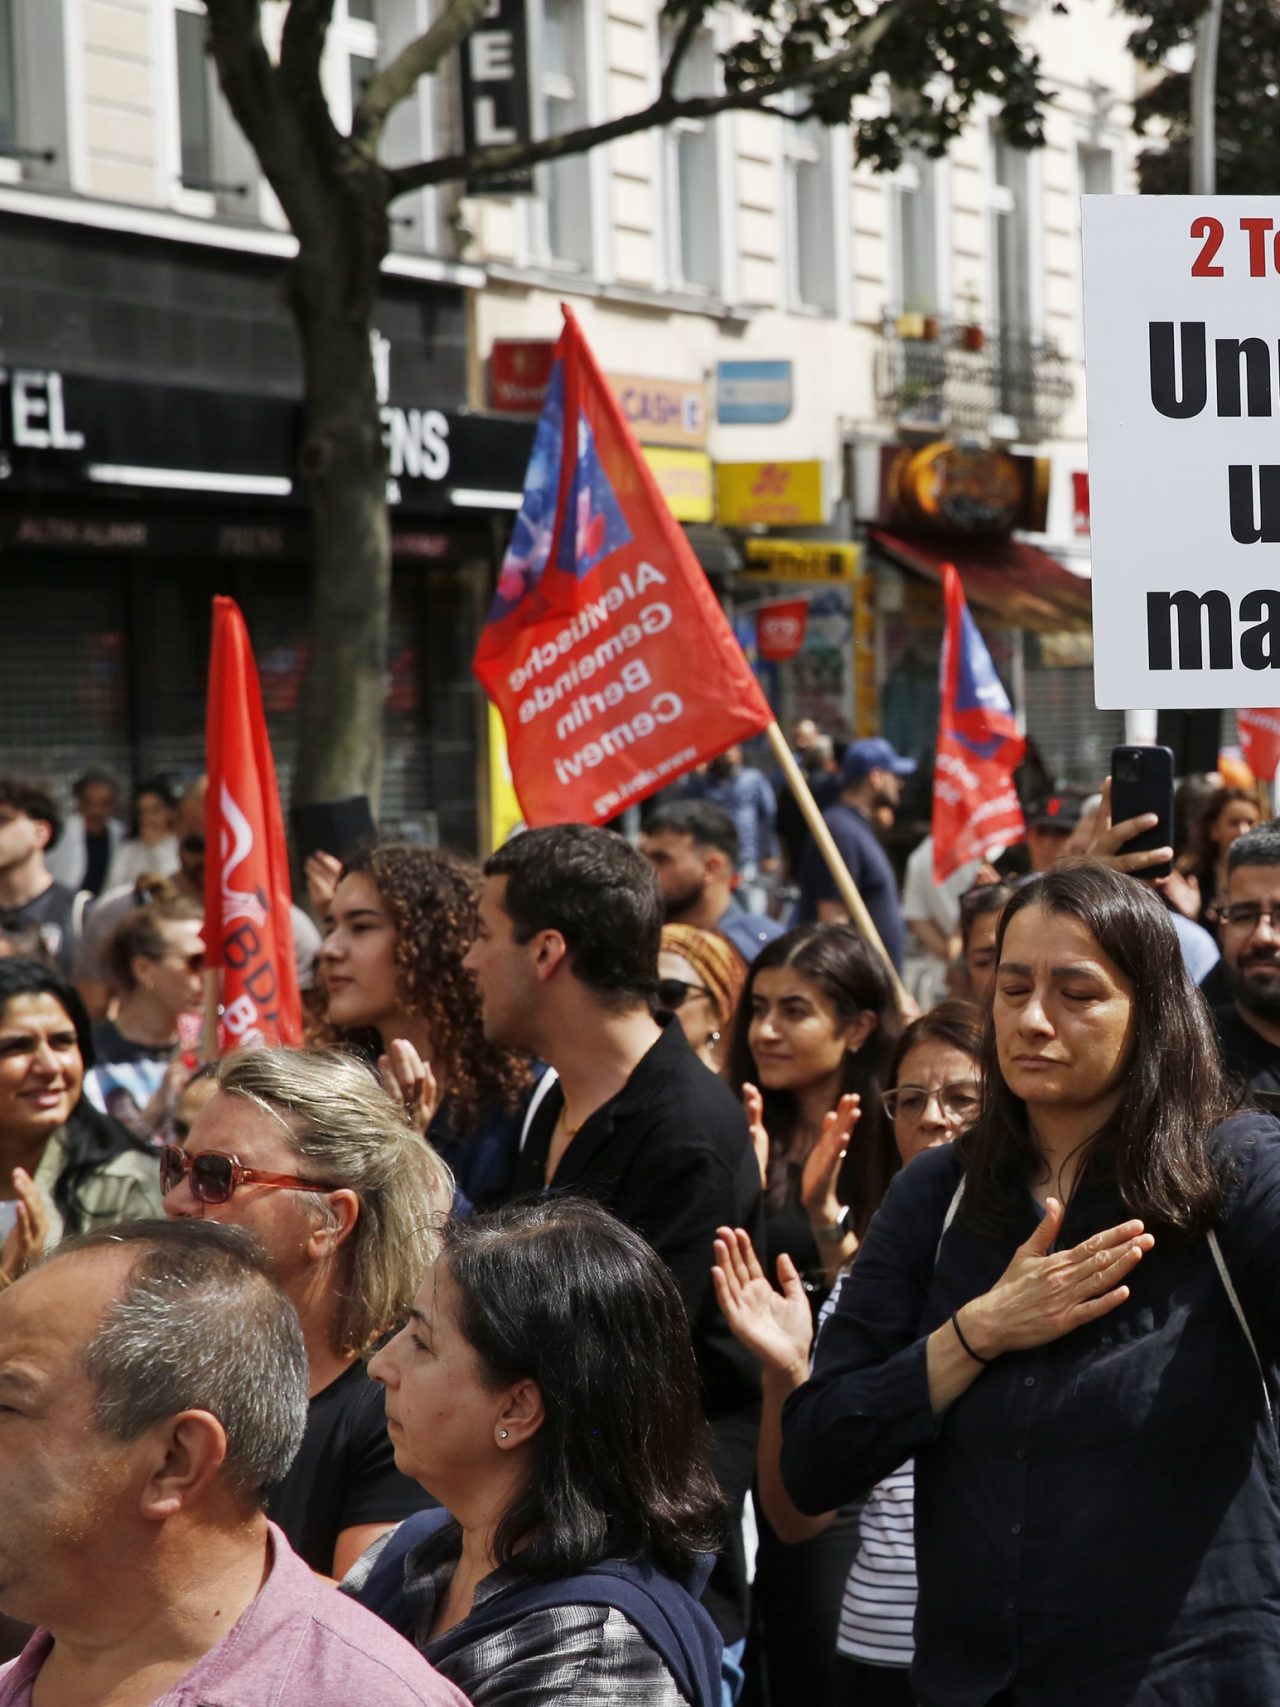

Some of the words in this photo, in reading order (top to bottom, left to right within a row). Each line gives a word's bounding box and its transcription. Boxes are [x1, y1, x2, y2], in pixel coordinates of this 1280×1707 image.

[469, 0, 517, 146] EL
[1189, 216, 1225, 278] 2
[0, 367, 86, 450] EL
